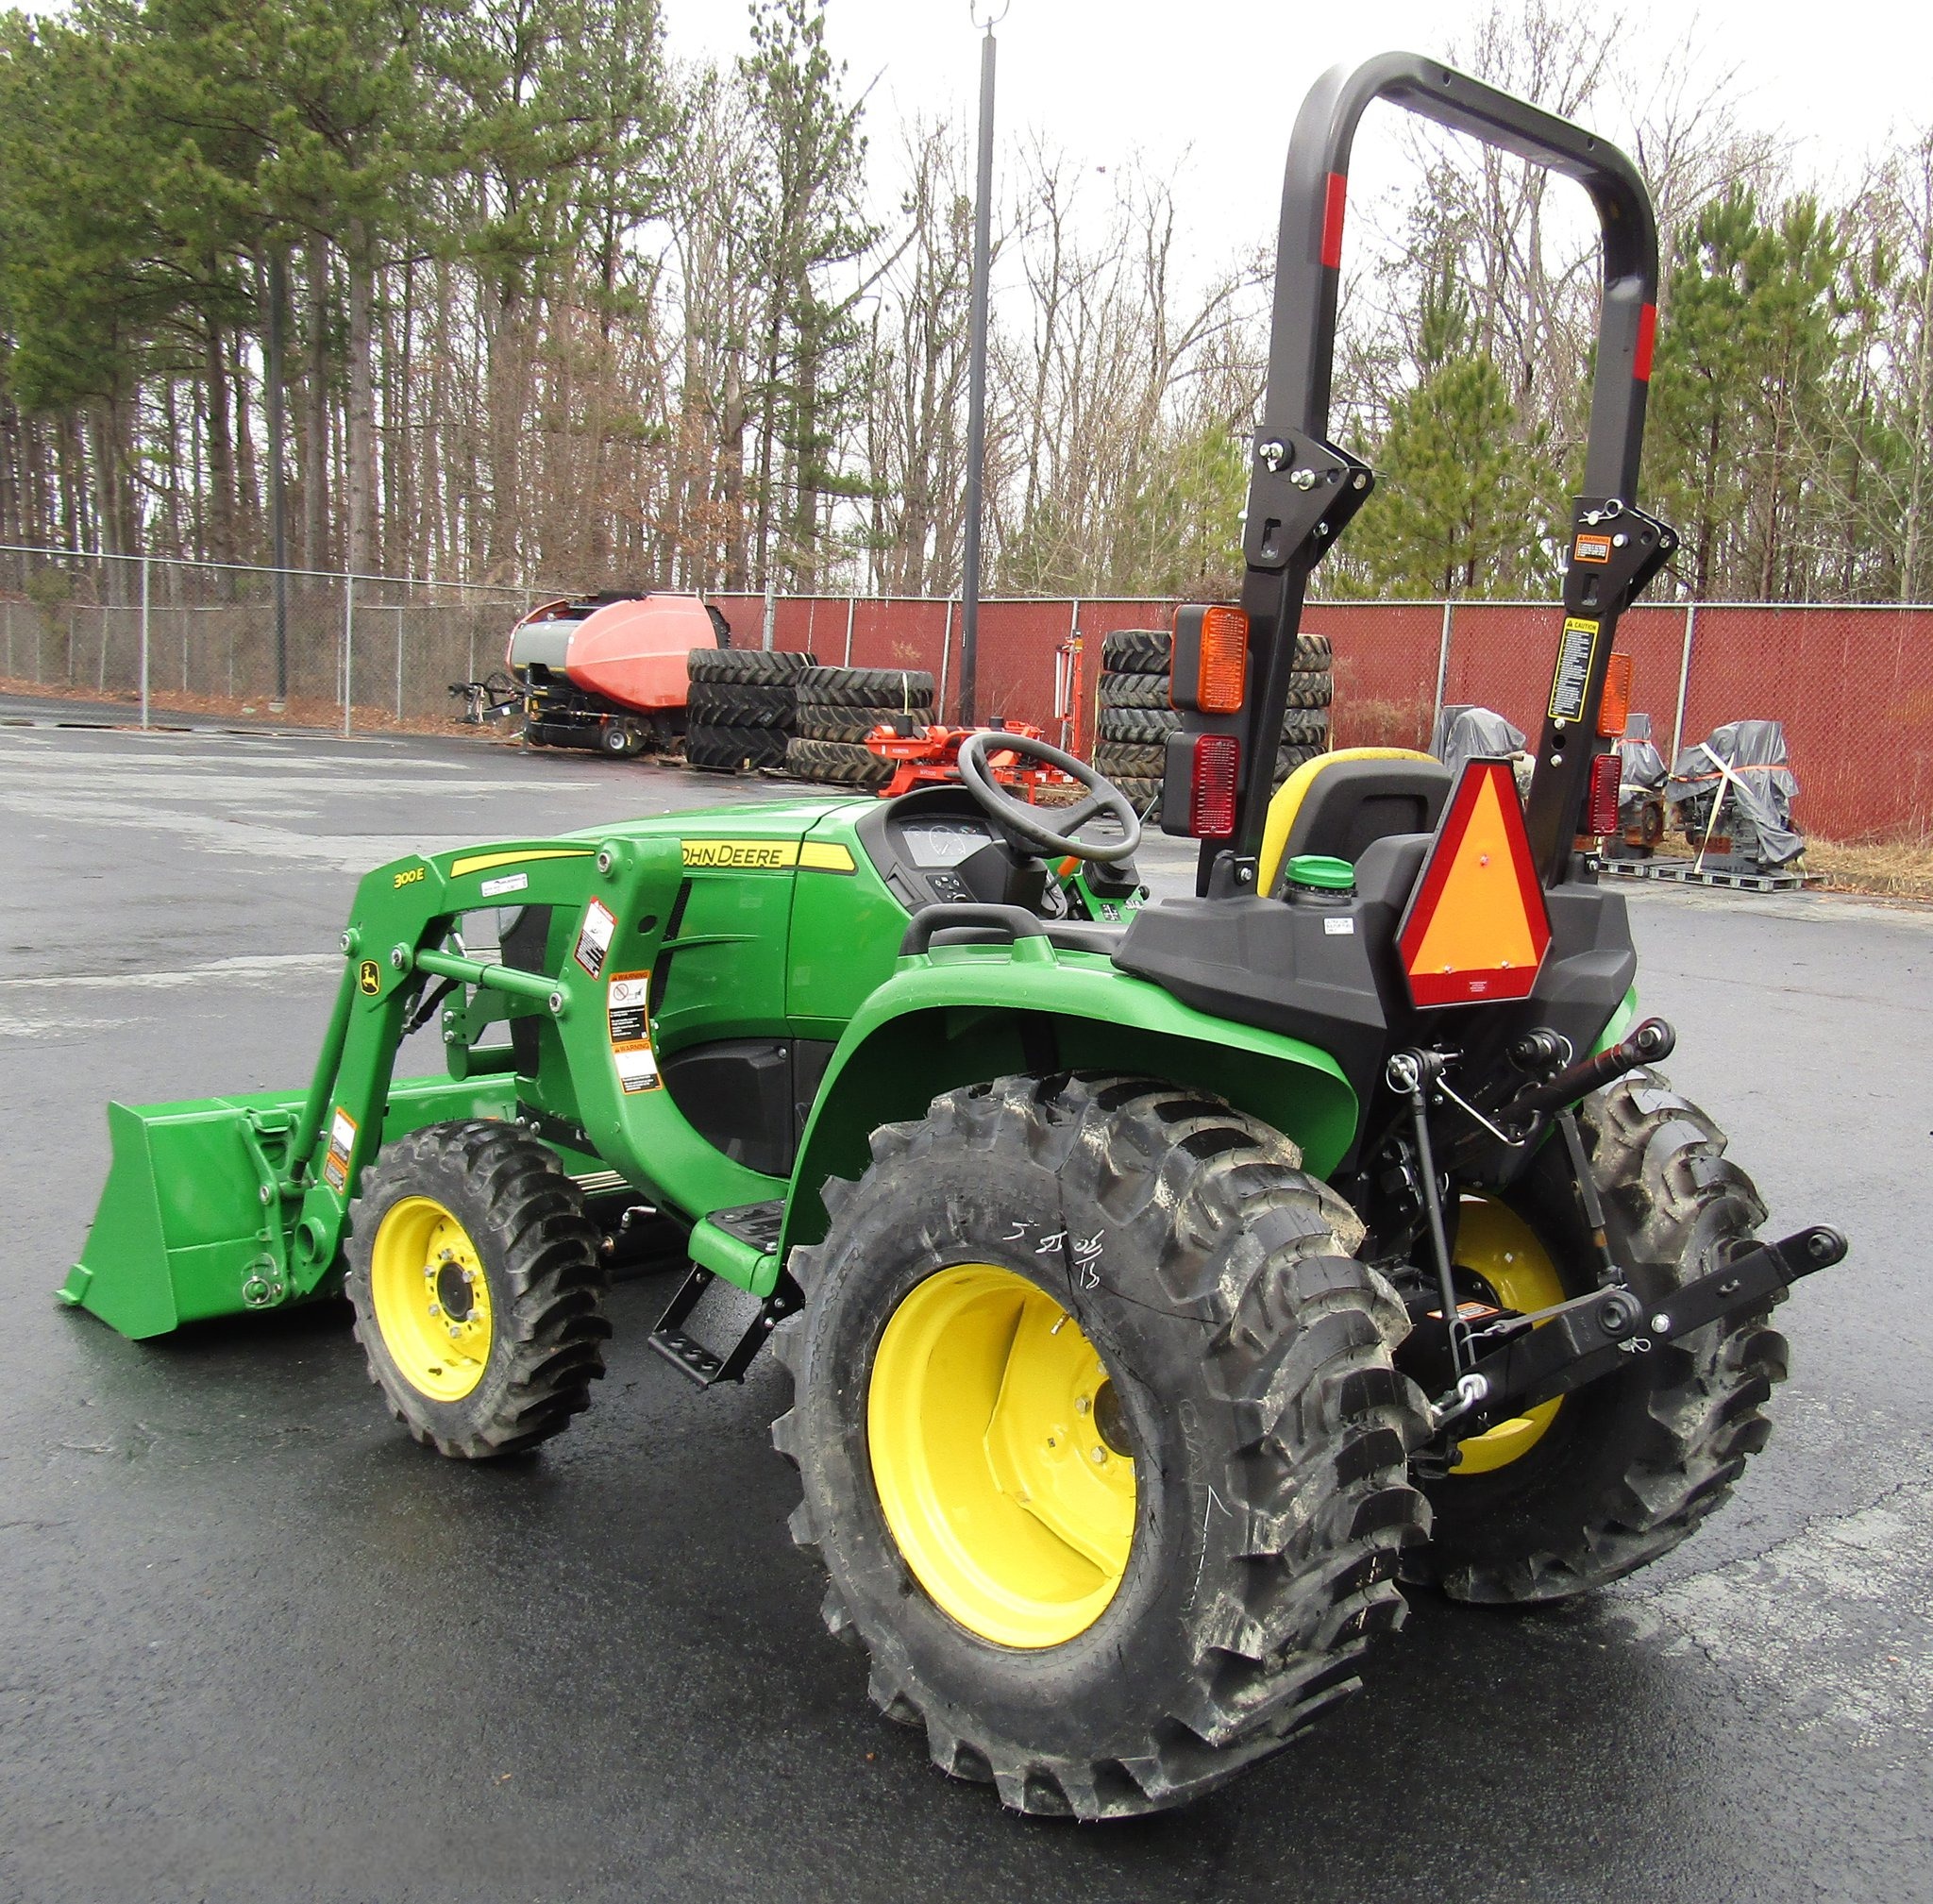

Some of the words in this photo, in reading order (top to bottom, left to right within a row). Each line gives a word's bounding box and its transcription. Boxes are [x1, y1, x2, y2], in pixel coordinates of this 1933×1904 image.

[1574, 621, 1597, 631] CAUTION
[682, 847, 715, 863] OHN
[717, 845, 782, 865] DEERE
[394, 867, 425, 888] 300E
[619, 971, 648, 980] WARNING
[619, 1042, 649, 1052] WARNING
